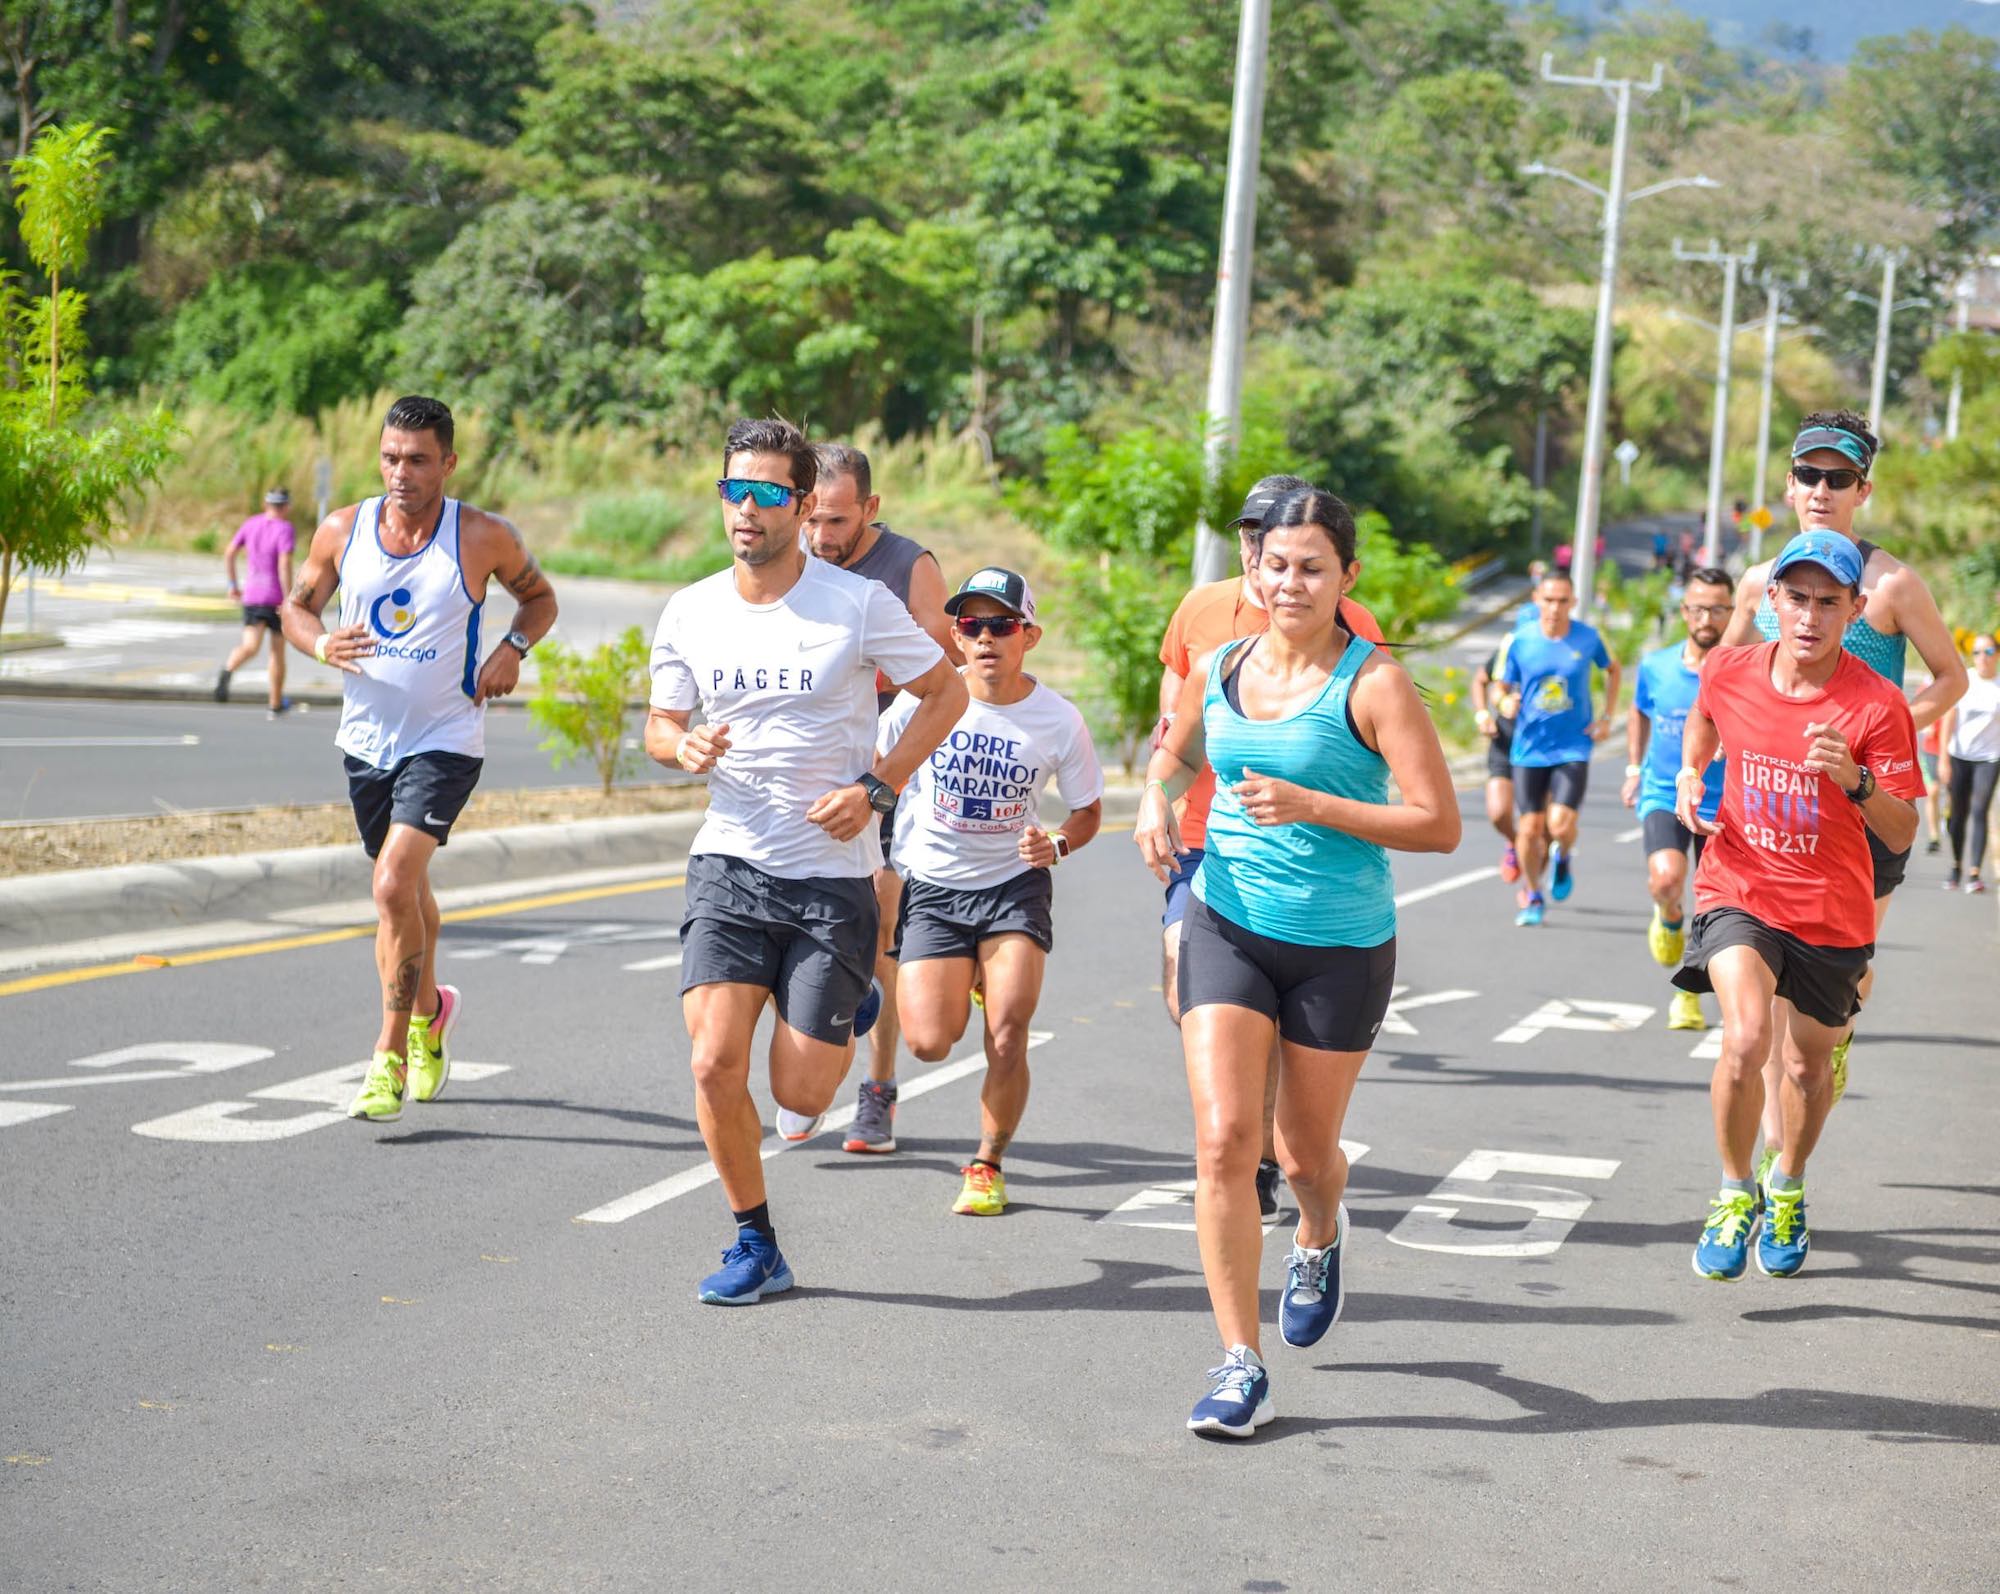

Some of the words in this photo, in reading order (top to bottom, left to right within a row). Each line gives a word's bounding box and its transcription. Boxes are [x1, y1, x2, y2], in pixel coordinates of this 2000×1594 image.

[930, 750, 1039, 784] CAMINOS
[1742, 760, 1819, 797] URBAN
[995, 803, 1022, 818] 10K
[1743, 785, 1819, 835] RUN
